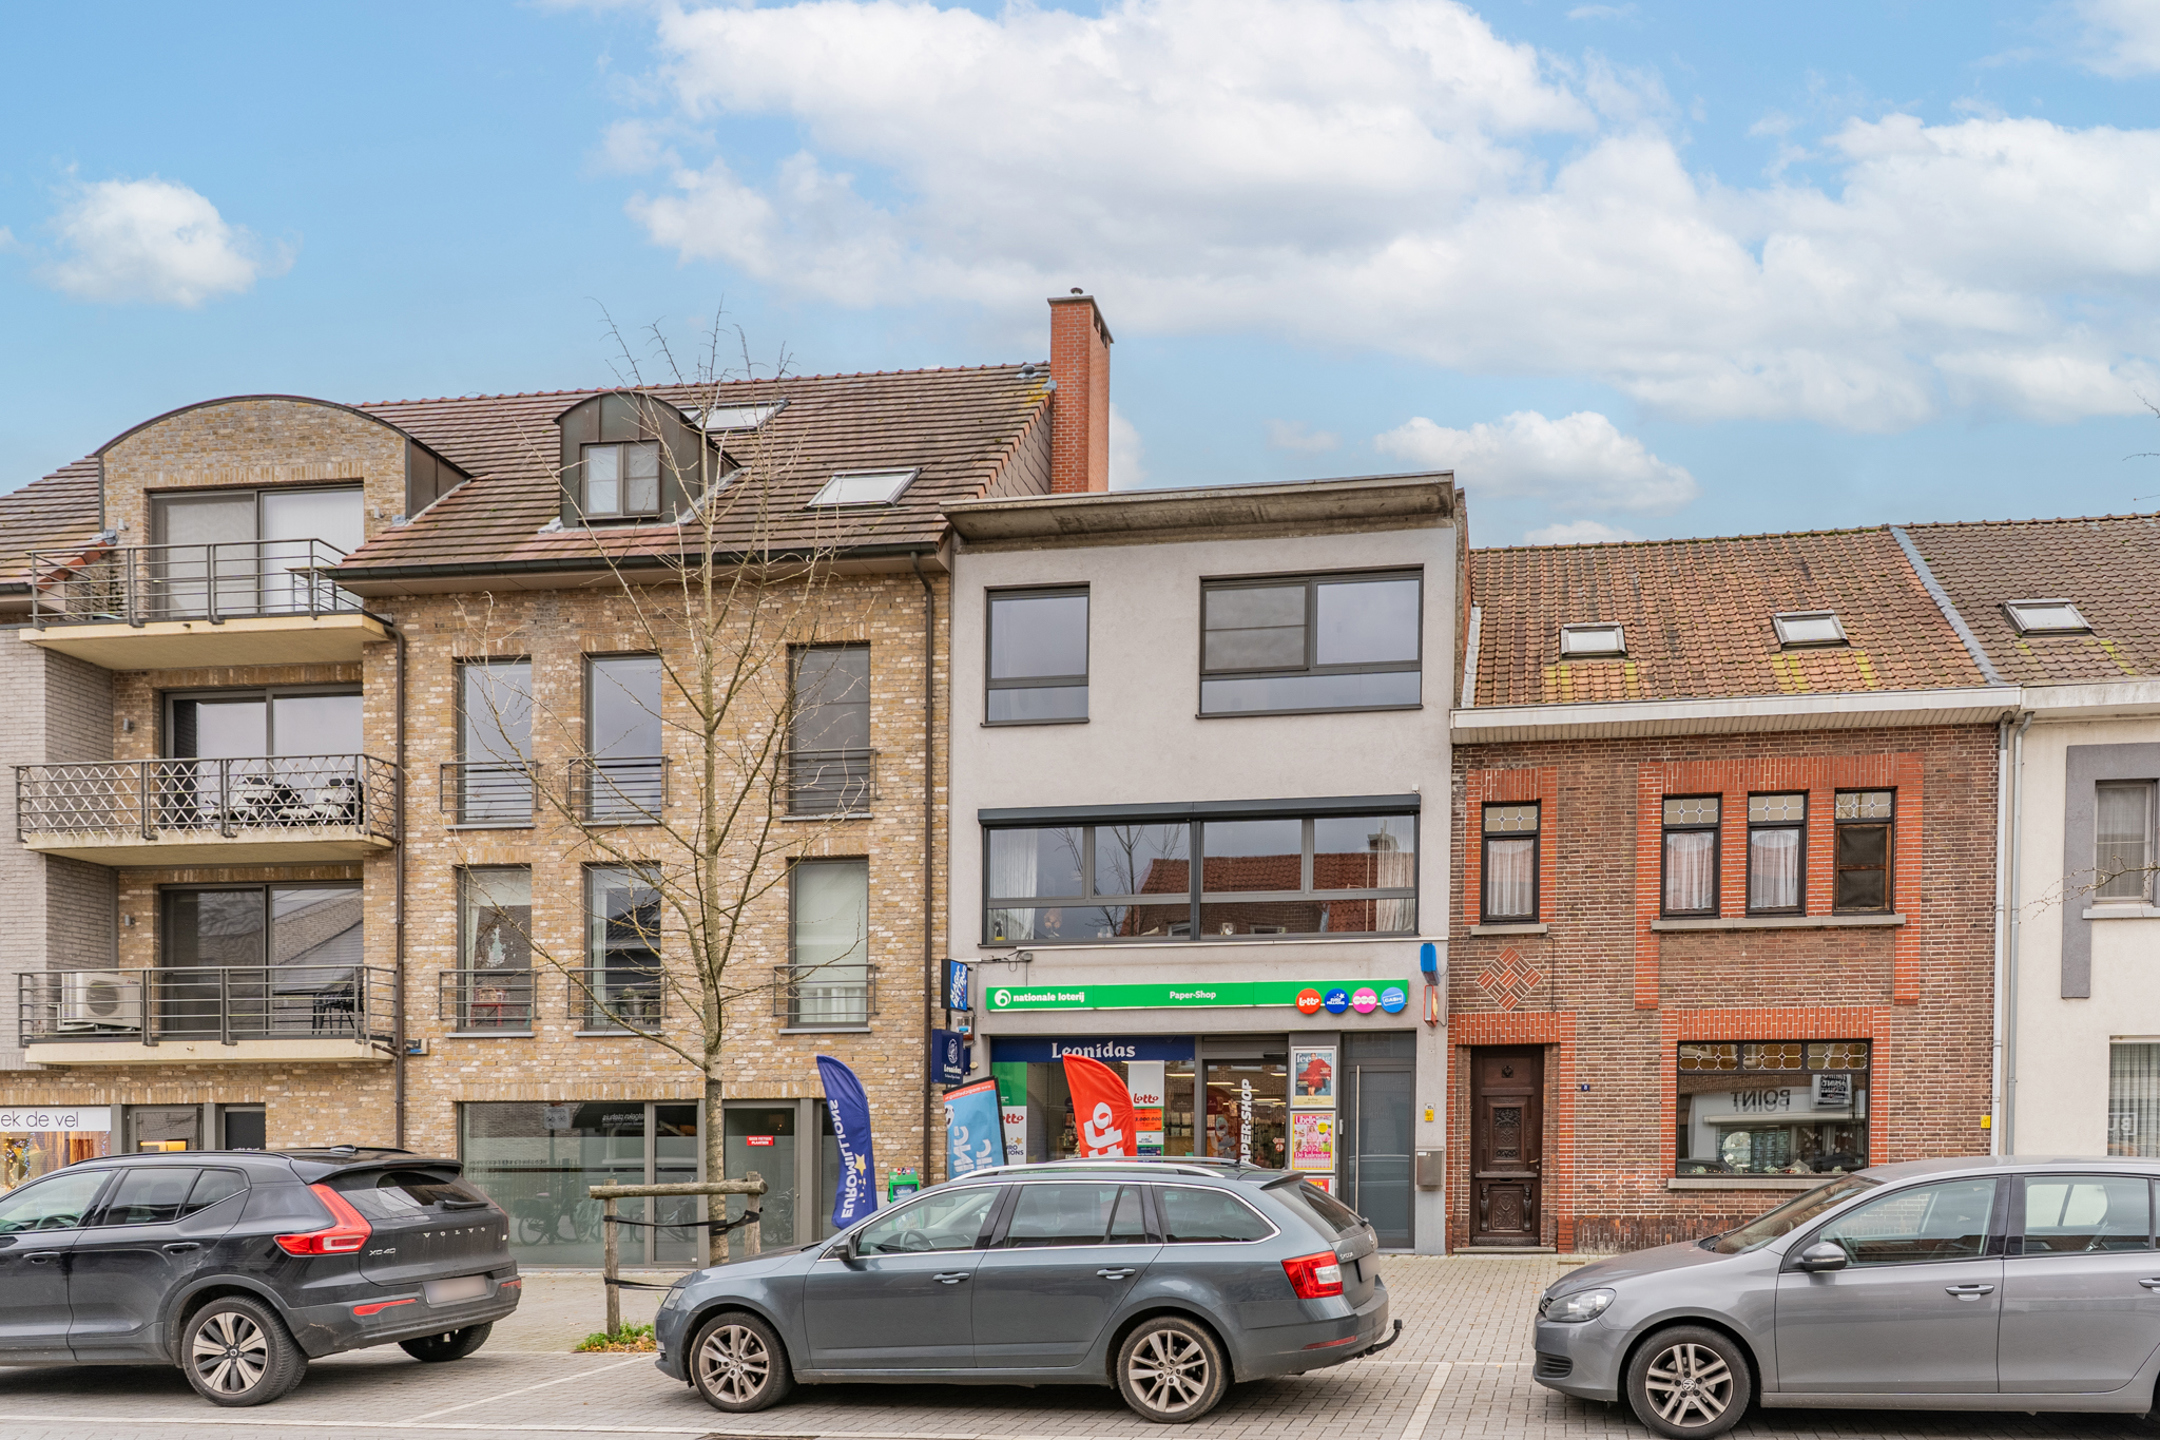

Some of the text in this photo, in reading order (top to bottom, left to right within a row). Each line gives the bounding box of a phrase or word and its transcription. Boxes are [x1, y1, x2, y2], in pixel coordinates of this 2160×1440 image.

[1013, 991, 1085, 1003] nationale loterij
[1169, 990, 1217, 1001] Paper-Shop
[1051, 1041, 1136, 1058] Leonidas
[0, 1110, 79, 1128] ek de vel
[423, 1226, 486, 1239] VOLVO
